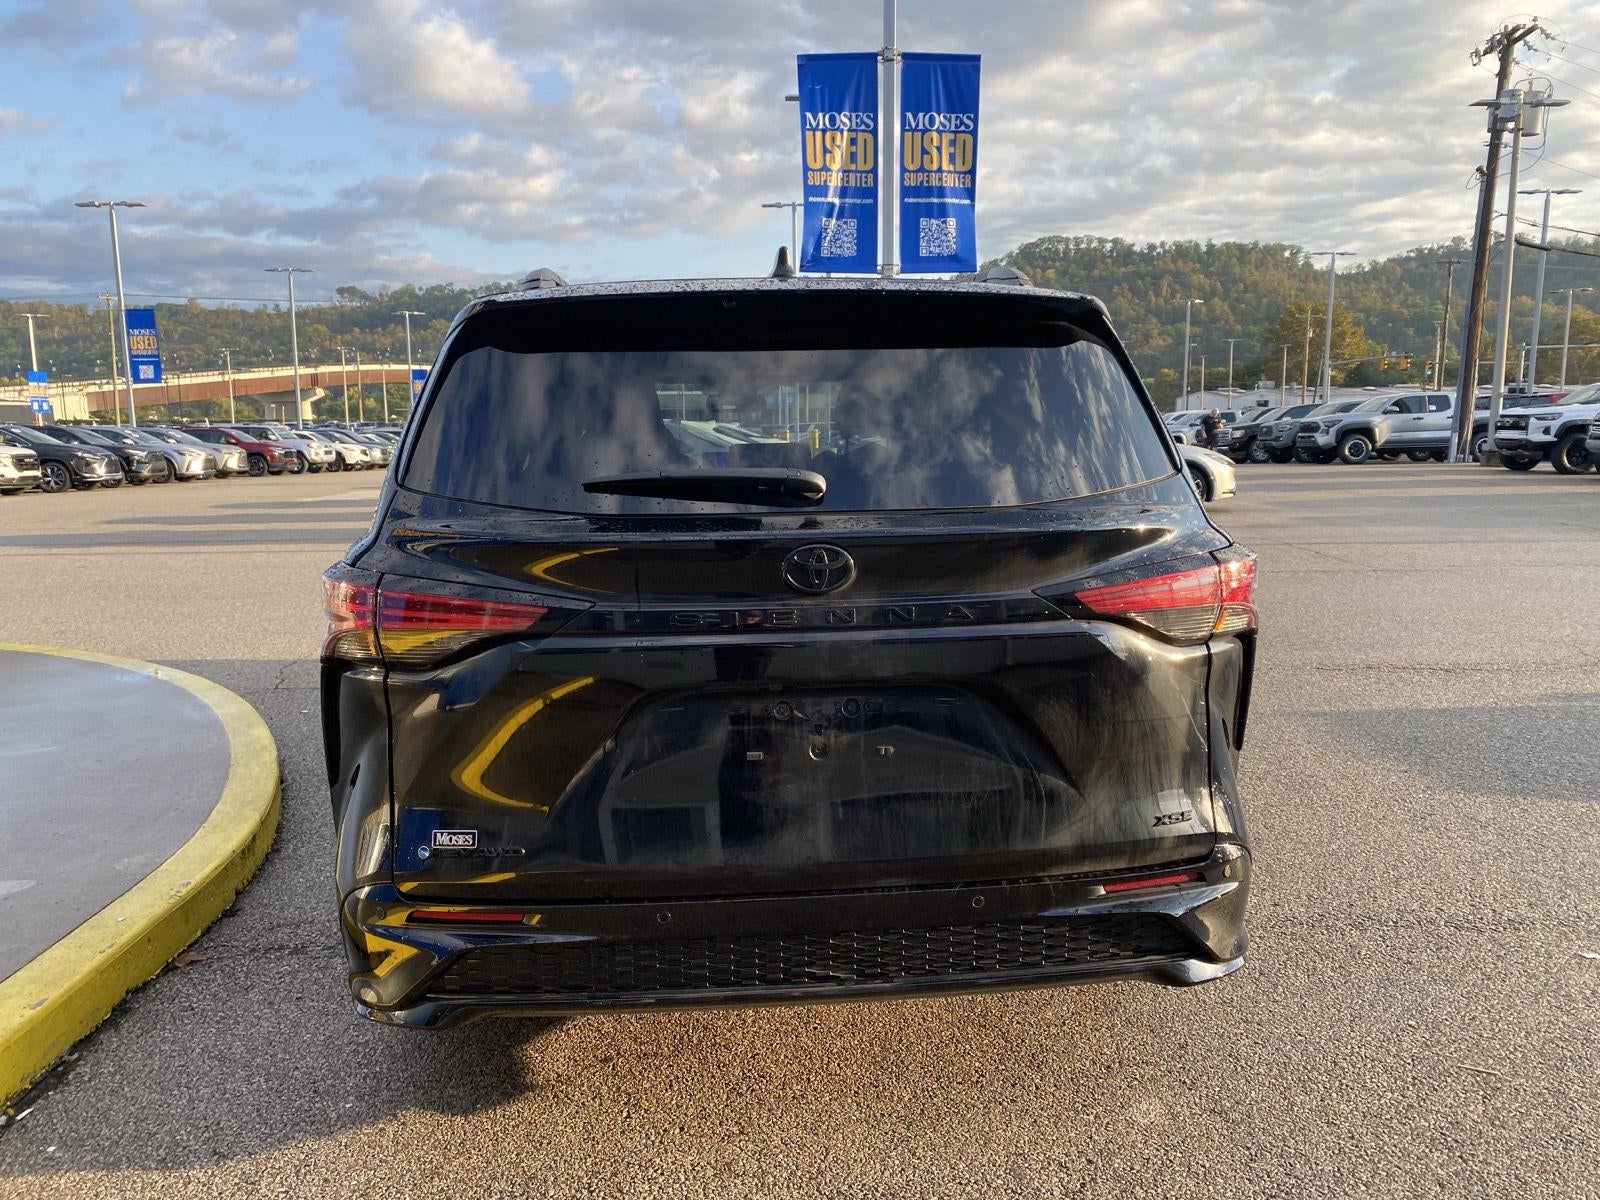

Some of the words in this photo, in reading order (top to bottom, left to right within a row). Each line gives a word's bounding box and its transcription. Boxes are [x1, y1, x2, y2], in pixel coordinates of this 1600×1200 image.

[805, 112, 874, 129] MOSES
[904, 112, 974, 130] MOSES
[805, 131, 874, 170] USED
[903, 131, 973, 171] USED
[807, 171, 874, 187] SUPERCENTER
[904, 172, 971, 187] SUPERCENTER
[129, 328, 156, 336] MOSES
[130, 336, 157, 349] USED
[669, 605, 976, 627] SIENNA
[1152, 810, 1192, 827] XSE
